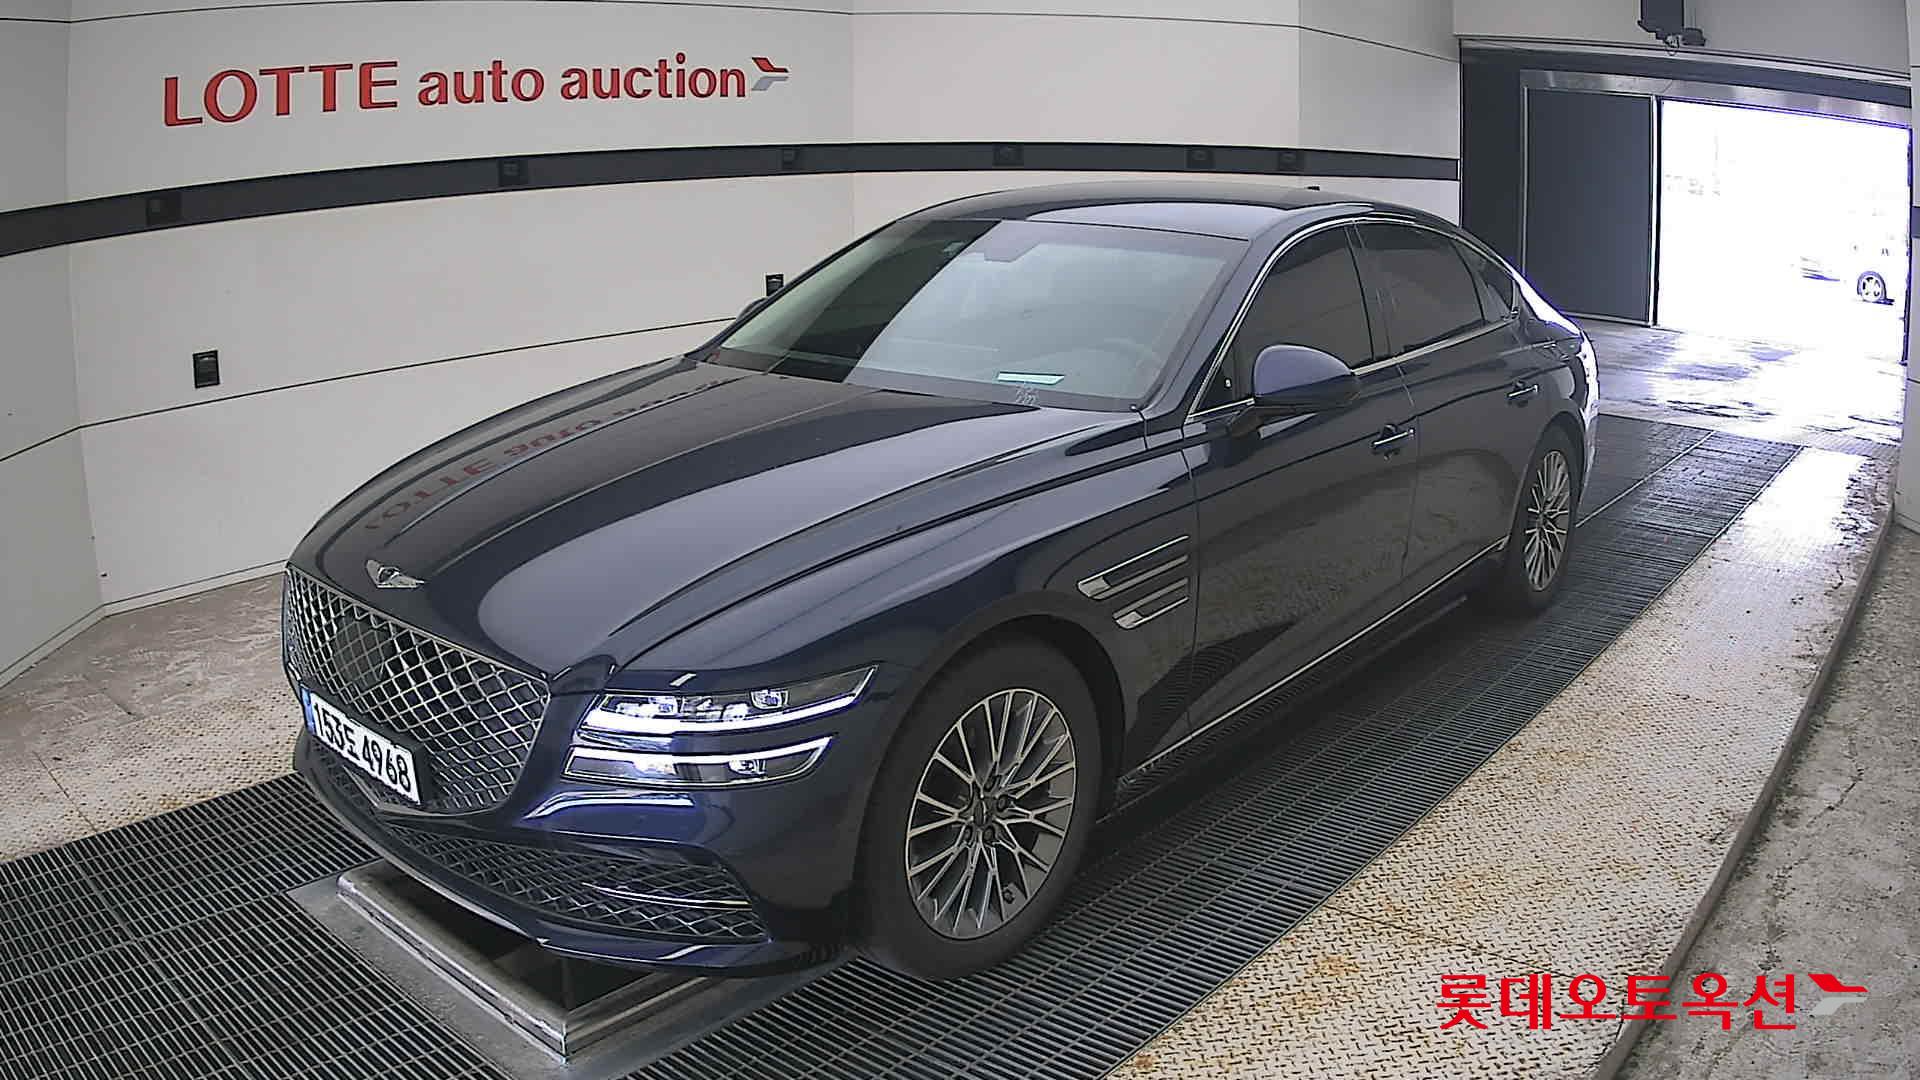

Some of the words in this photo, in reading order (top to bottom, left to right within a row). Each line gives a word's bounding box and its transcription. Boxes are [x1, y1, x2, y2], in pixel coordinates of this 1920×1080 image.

[162, 60, 399, 127] LOTTE
[417, 60, 546, 106] auto
[560, 52, 747, 100] auction
[361, 734, 412, 793] 4968
